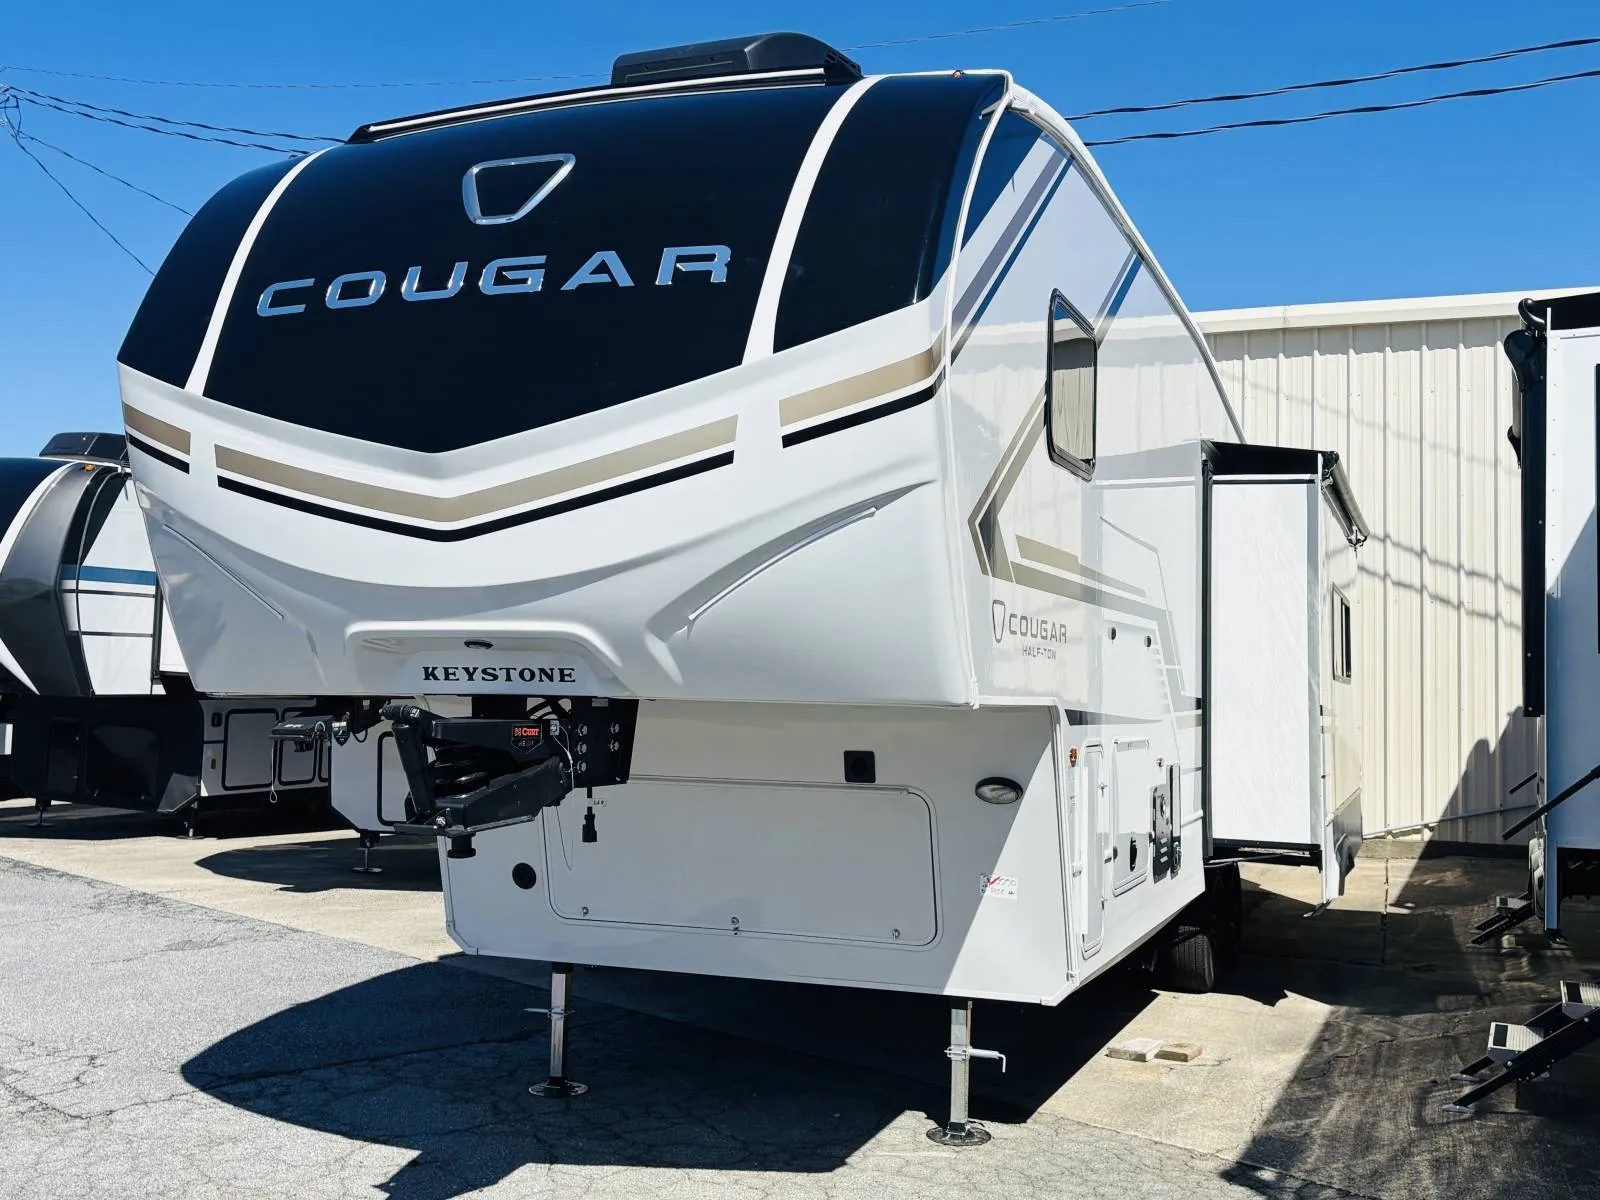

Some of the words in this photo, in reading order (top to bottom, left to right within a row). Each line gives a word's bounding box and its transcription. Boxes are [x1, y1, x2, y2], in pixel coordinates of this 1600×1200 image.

[256, 244, 732, 317] COUGAR
[1009, 614, 1067, 643] COUGAR
[1023, 645, 1056, 660] HALF-TON
[422, 666, 576, 682] KEYSTONE
